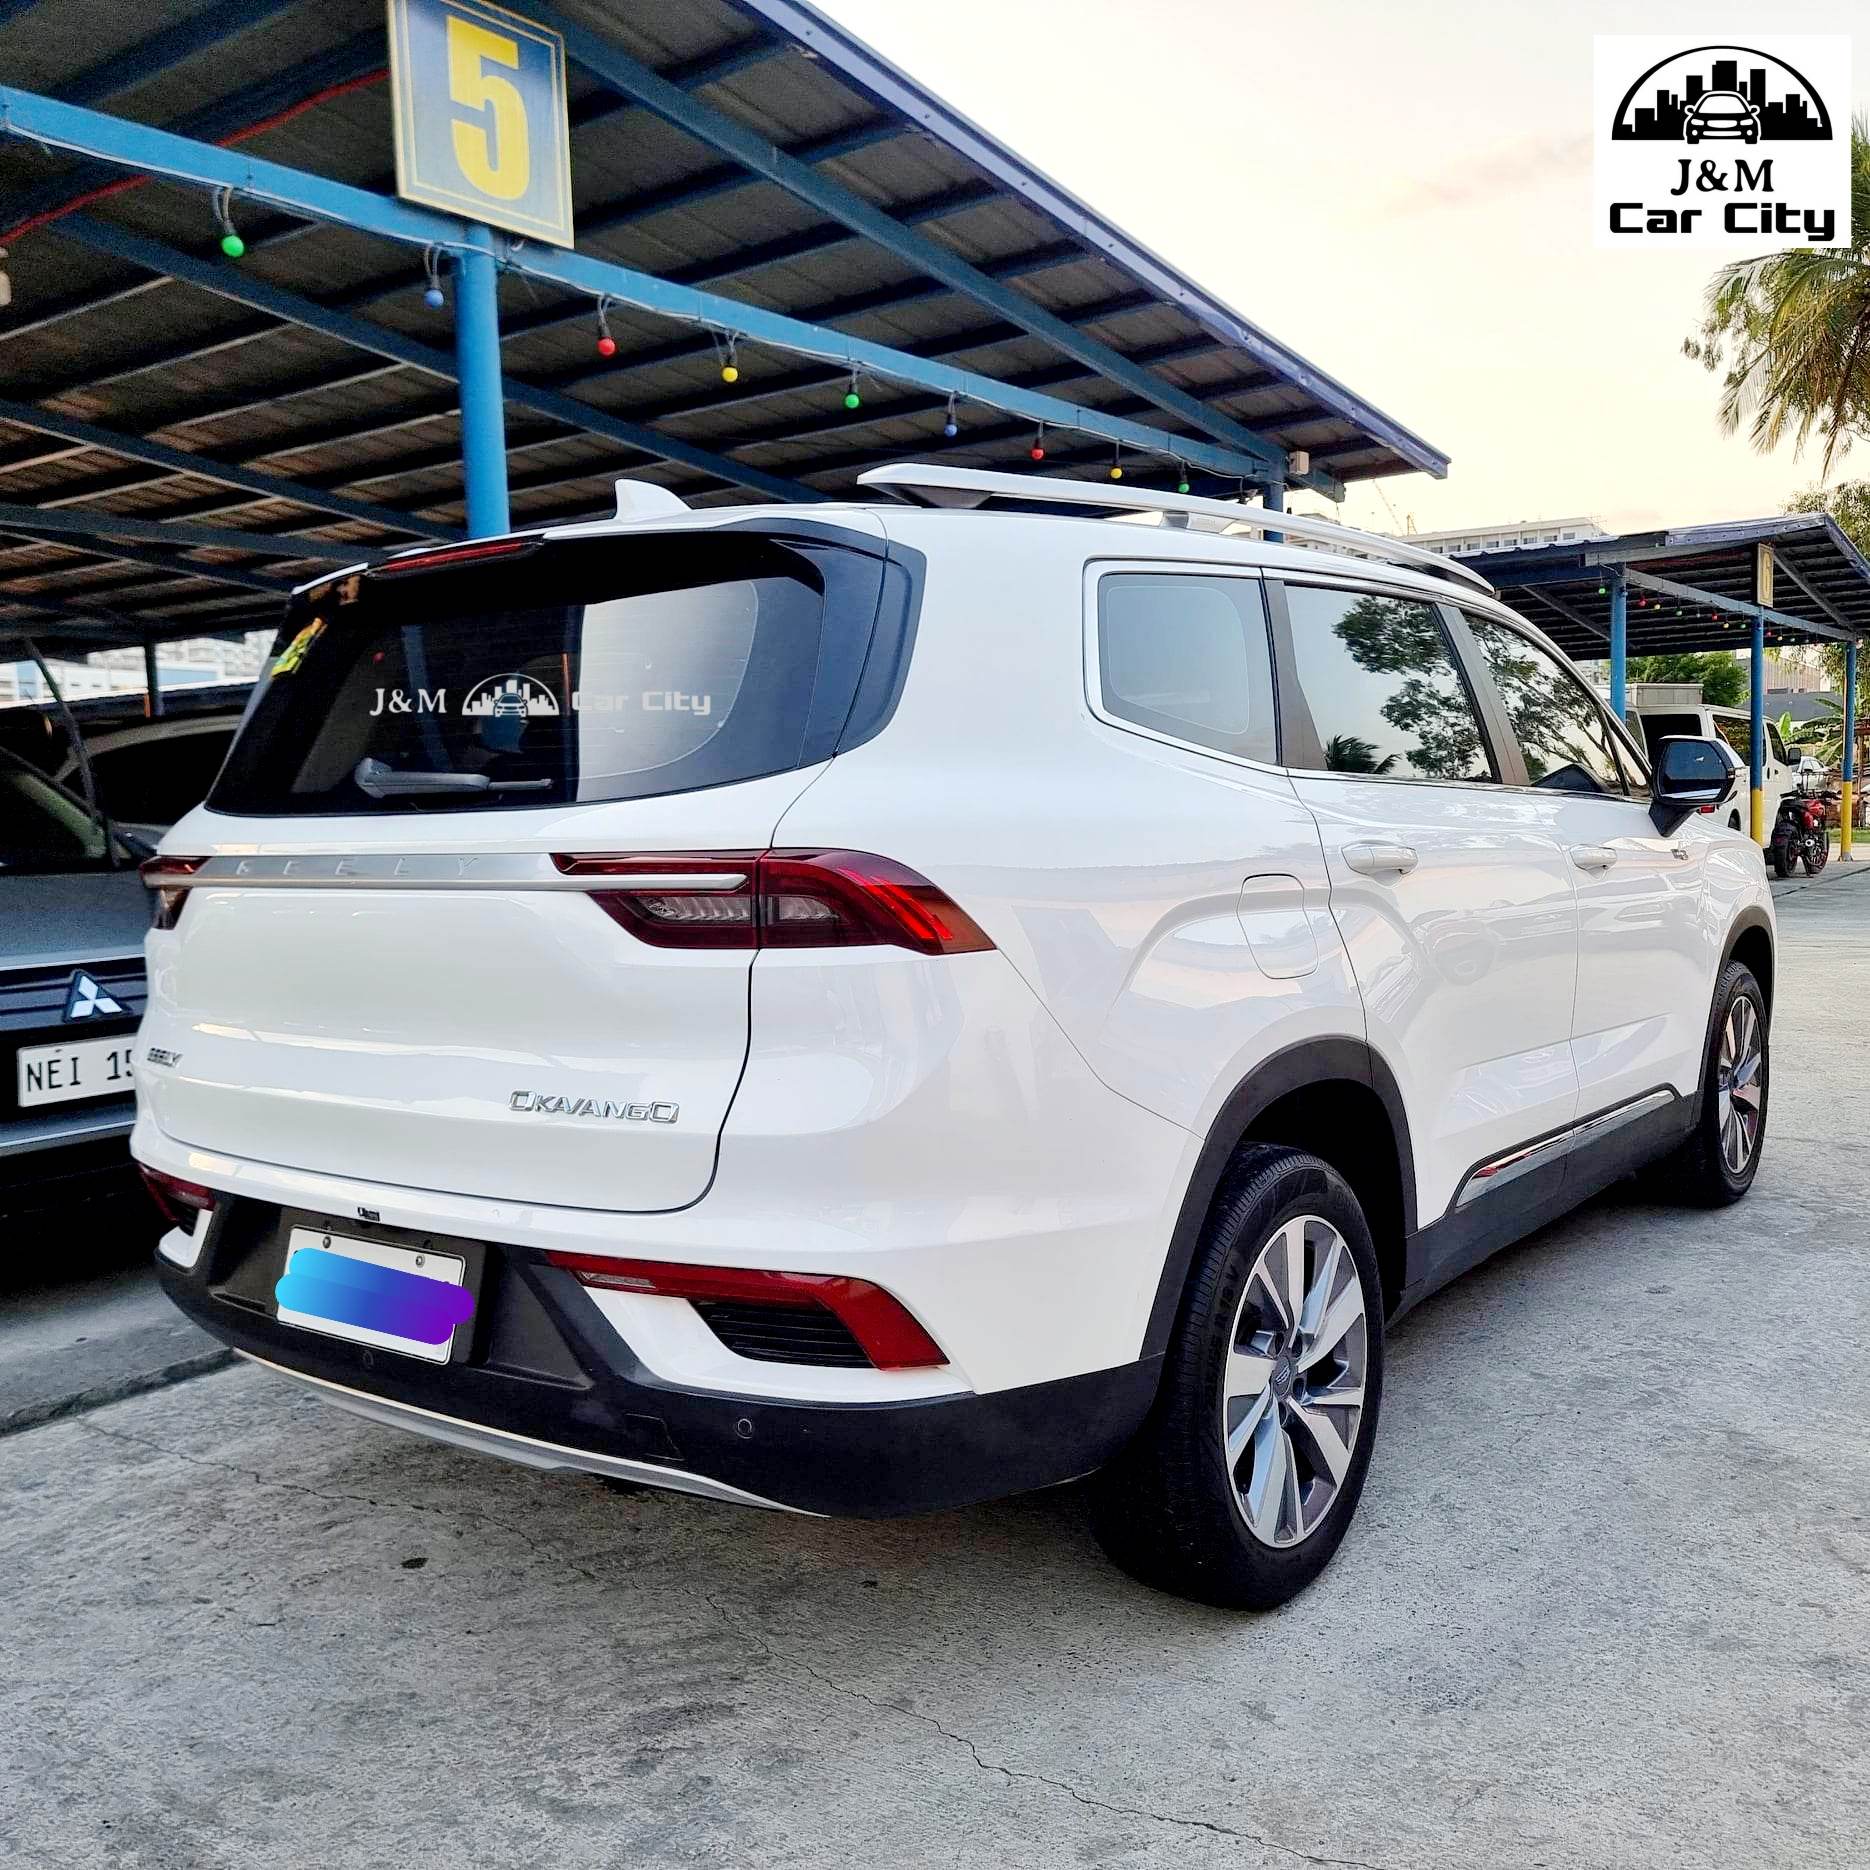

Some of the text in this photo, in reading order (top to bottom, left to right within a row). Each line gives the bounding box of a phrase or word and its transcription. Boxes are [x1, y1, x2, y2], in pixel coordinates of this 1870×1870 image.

[447, 14, 531, 200] 5
[27, 1057, 81, 1092] NEI
[509, 1090, 679, 1124] OKAVANGO
